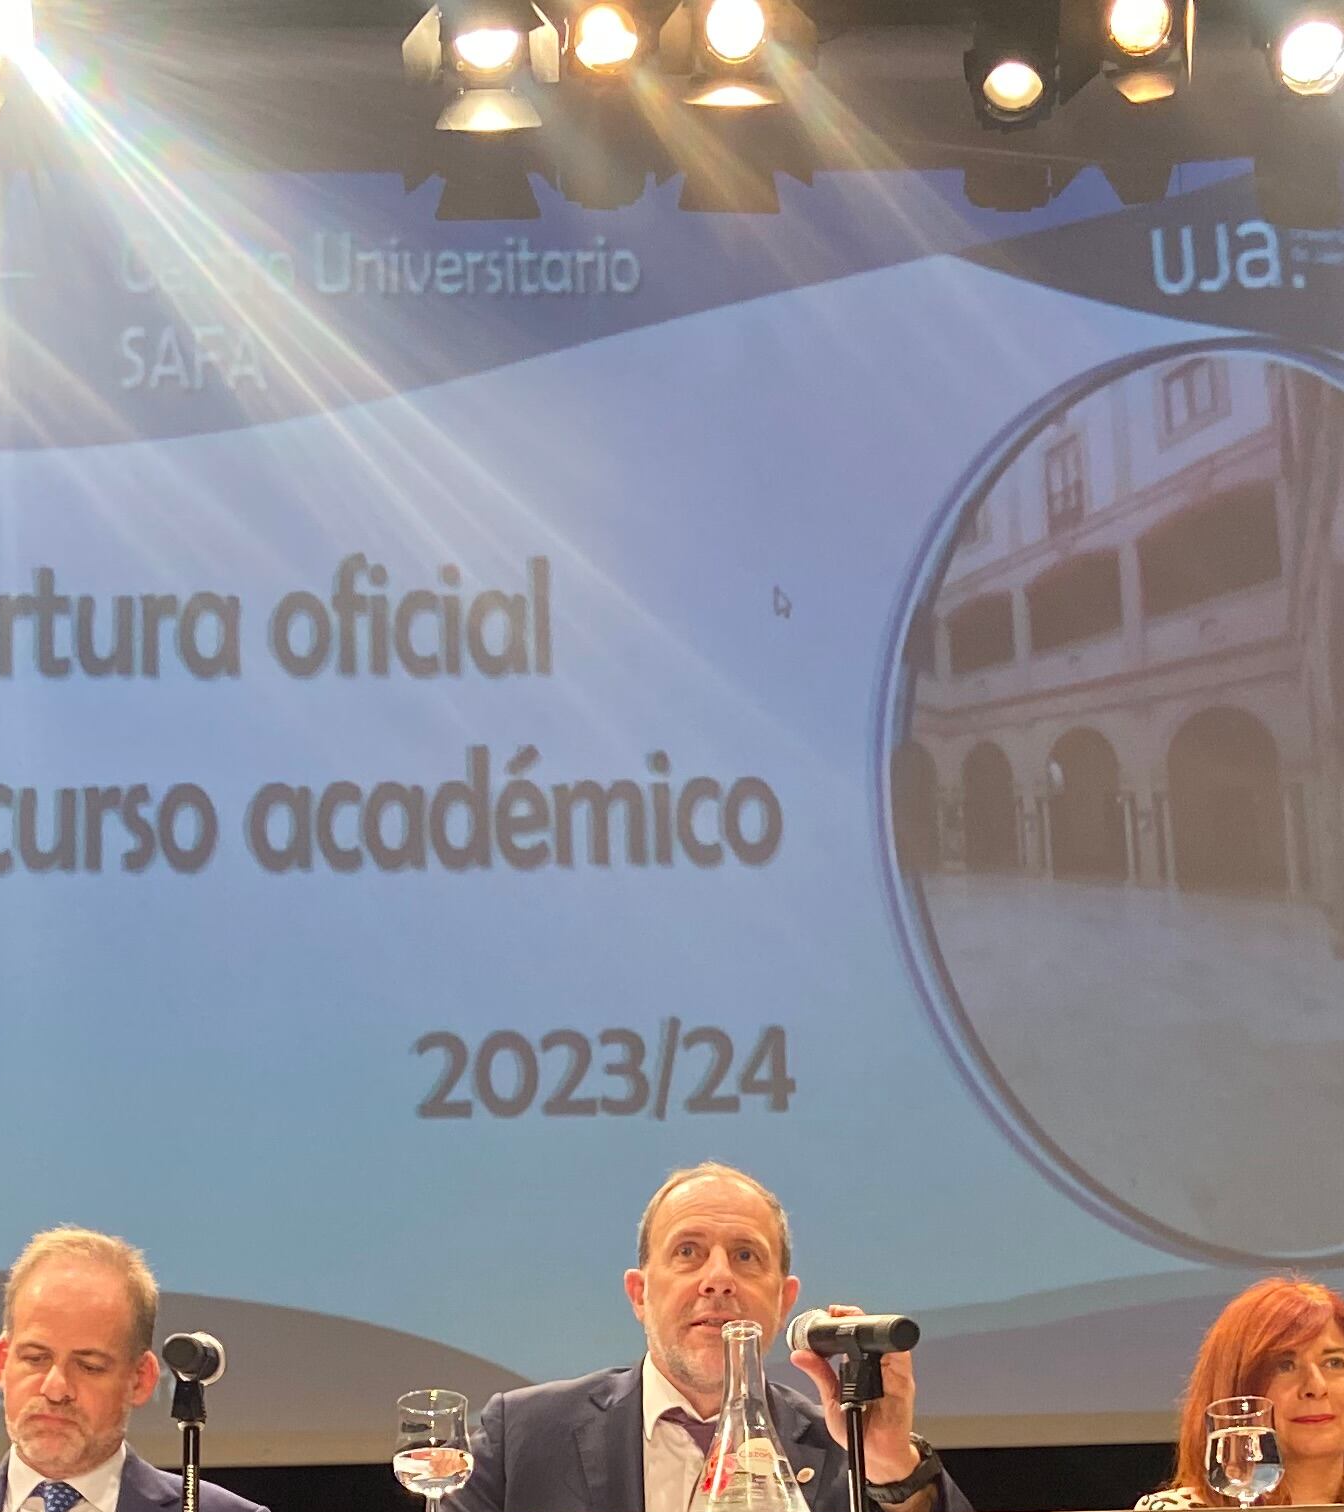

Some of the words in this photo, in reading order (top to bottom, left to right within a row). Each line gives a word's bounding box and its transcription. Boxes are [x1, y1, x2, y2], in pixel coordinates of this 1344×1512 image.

[311, 232, 642, 296] Universitario
[118, 325, 270, 392] SAFA
[268, 552, 553, 681] oficial
[244, 743, 785, 874] académico
[412, 1016, 798, 1121] 2023/24
